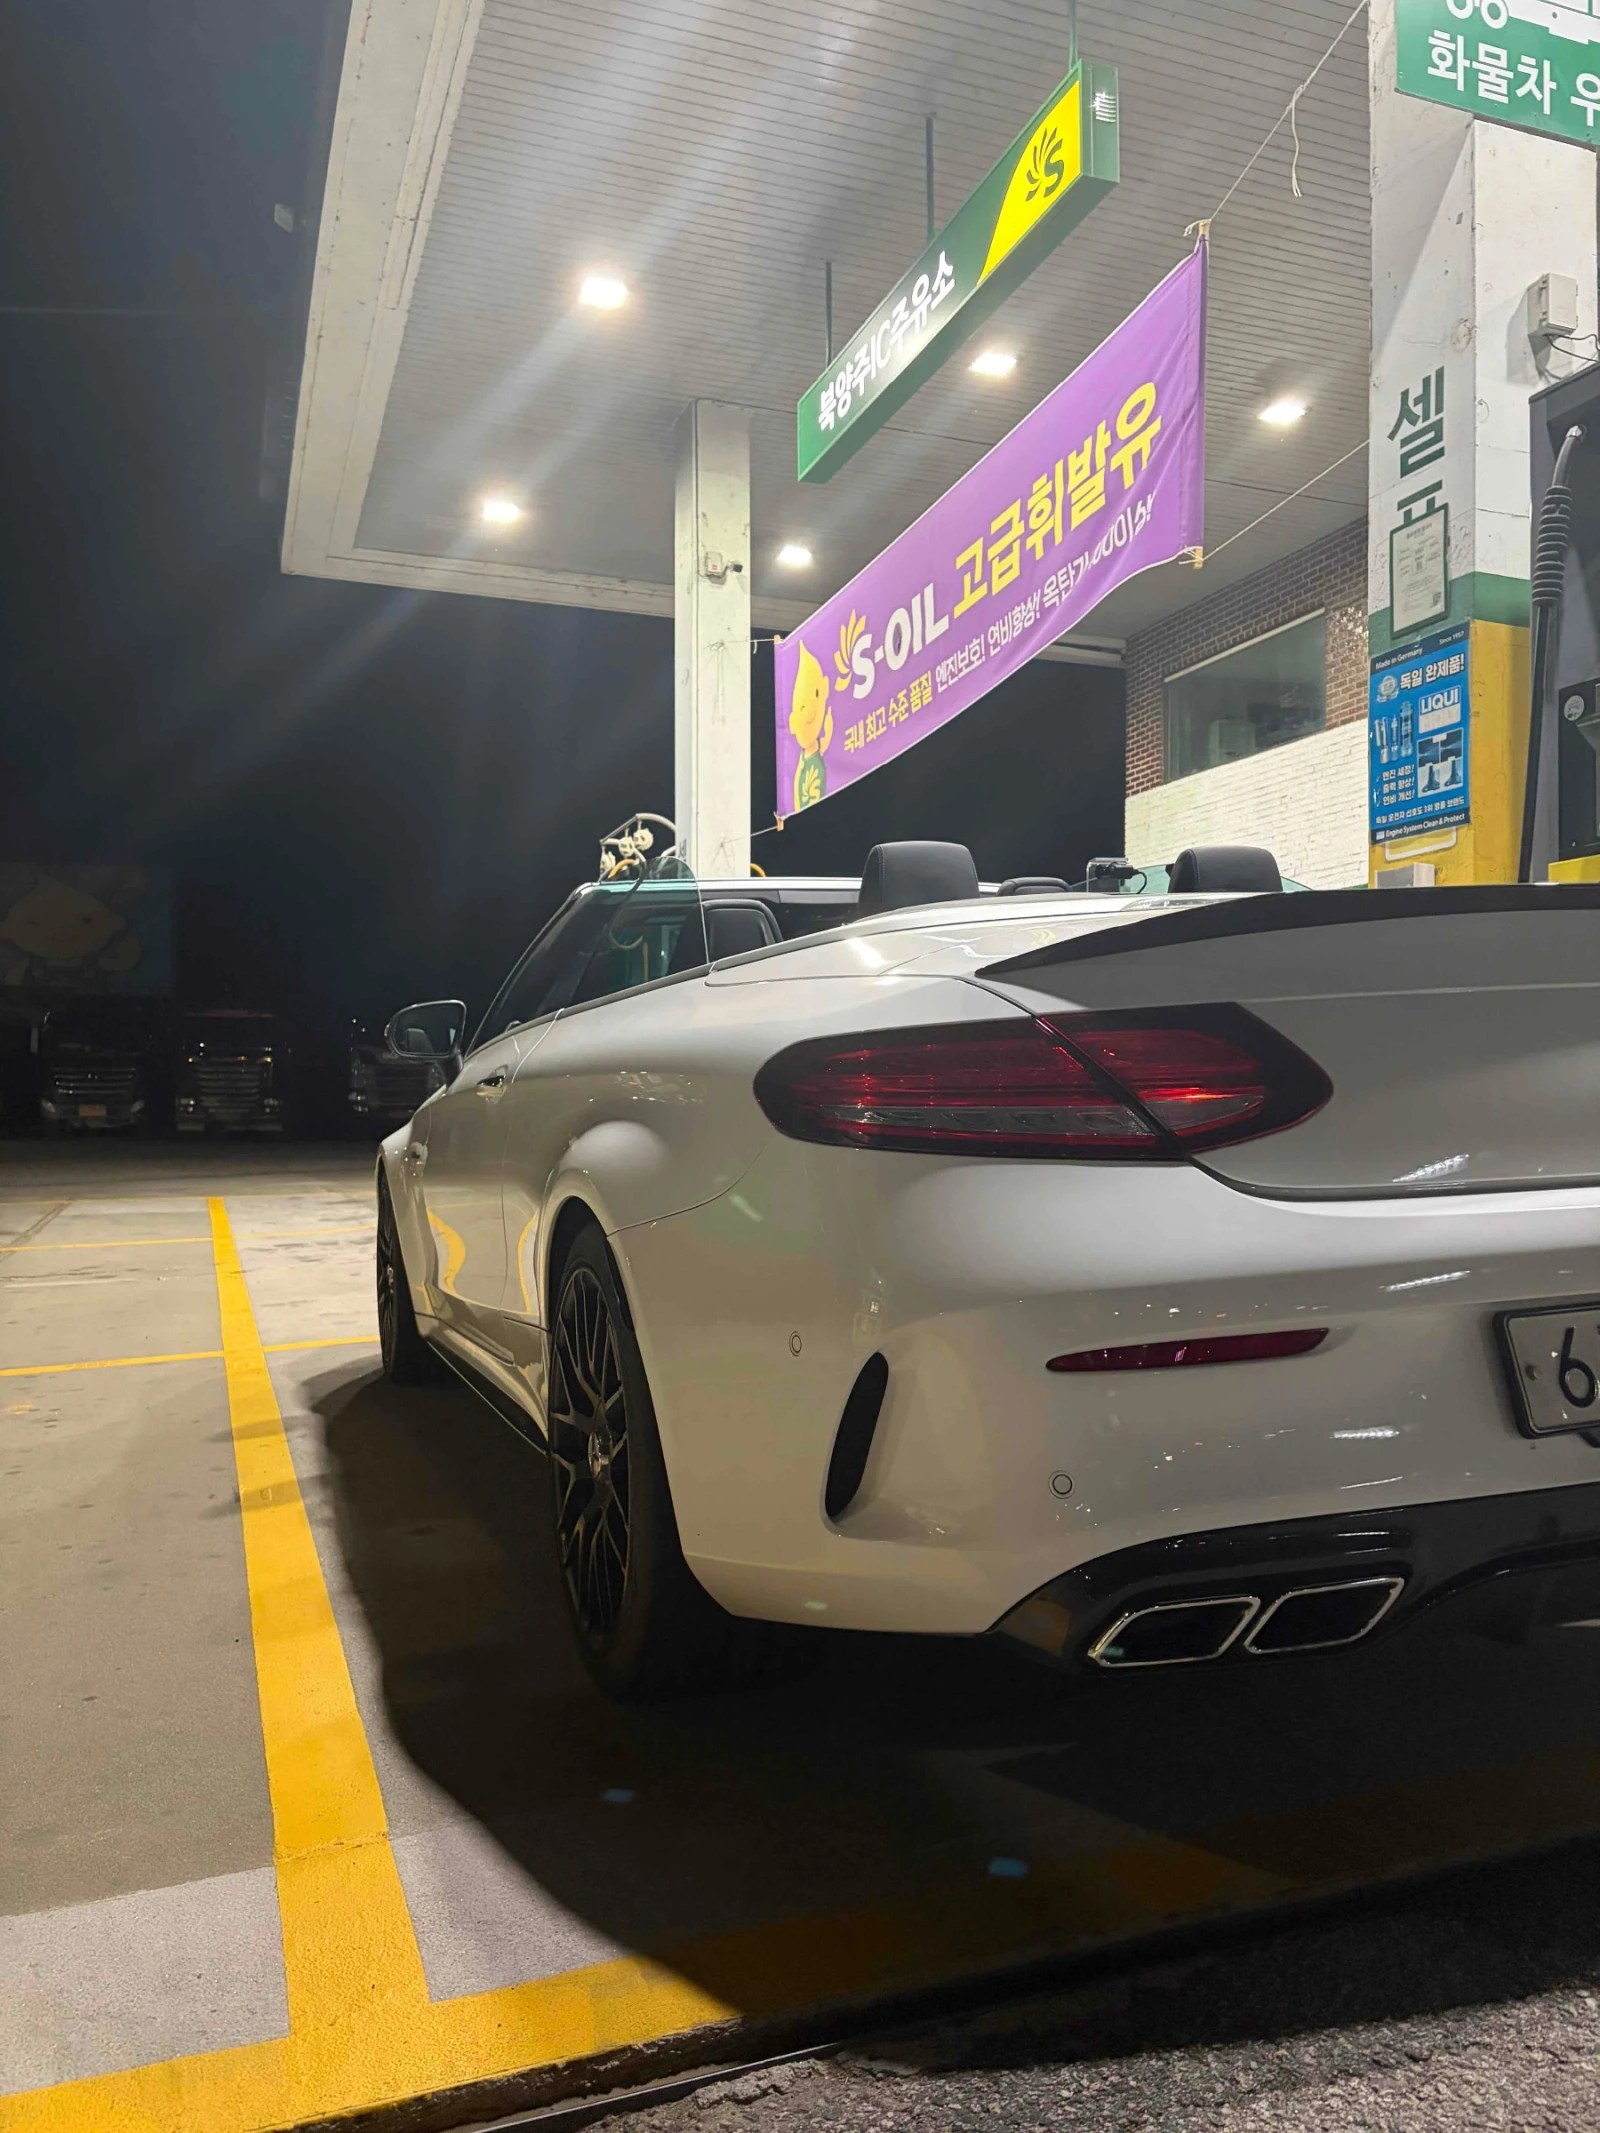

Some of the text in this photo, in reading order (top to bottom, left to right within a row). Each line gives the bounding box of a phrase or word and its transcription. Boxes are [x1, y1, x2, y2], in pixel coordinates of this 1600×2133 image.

[1427, 30, 1557, 115] 화물차
[818, 250, 956, 431] 북양주IC주유소
[852, 382, 1162, 700] S-OIL 고급휘발유
[1375, 658, 1391, 670] Made
[1397, 647, 1423, 662] Germany
[1400, 668, 1423, 690] 독일
[1425, 653, 1465, 683] 완제품!
[844, 719, 865, 753] 국내
[866, 706, 887, 743] 최고
[888, 689, 909, 728] 수준
[910, 670, 933, 713] 품질
[1421, 688, 1459, 714] LIQUI
[1385, 827, 1403, 838] Engine
[1403, 822, 1423, 834] System
[1423, 819, 1439, 829] Clean
[1443, 813, 1465, 823] Protect
[1559, 1325, 1600, 1408] 6
